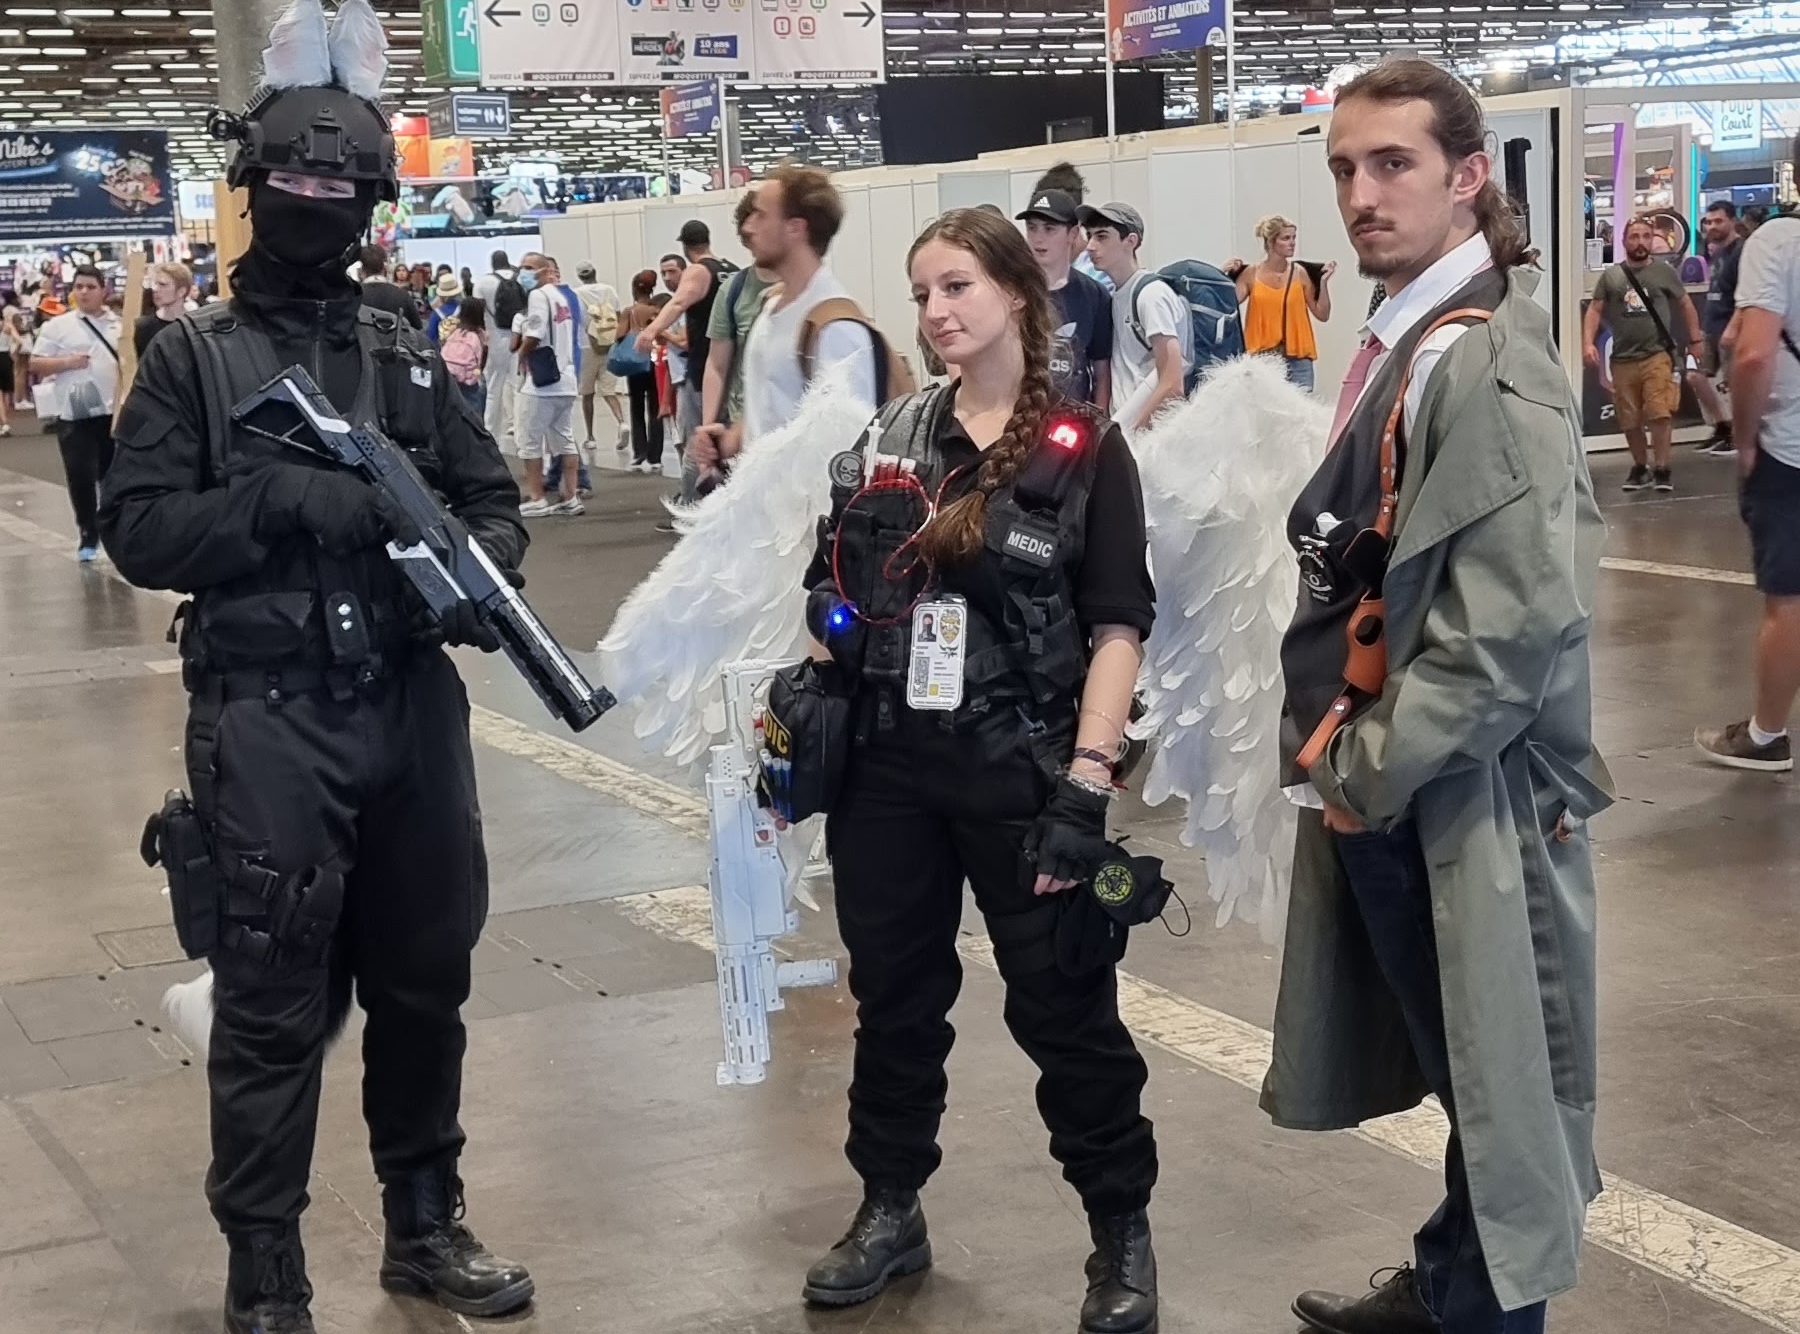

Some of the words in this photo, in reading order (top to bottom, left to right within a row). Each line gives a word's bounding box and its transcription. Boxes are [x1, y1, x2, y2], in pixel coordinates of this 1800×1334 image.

[1157, 6, 1167, 21] ET
[1721, 114, 1753, 131] Court
[1007, 530, 1053, 558] MEDIC
[764, 711, 788, 755] DIC
